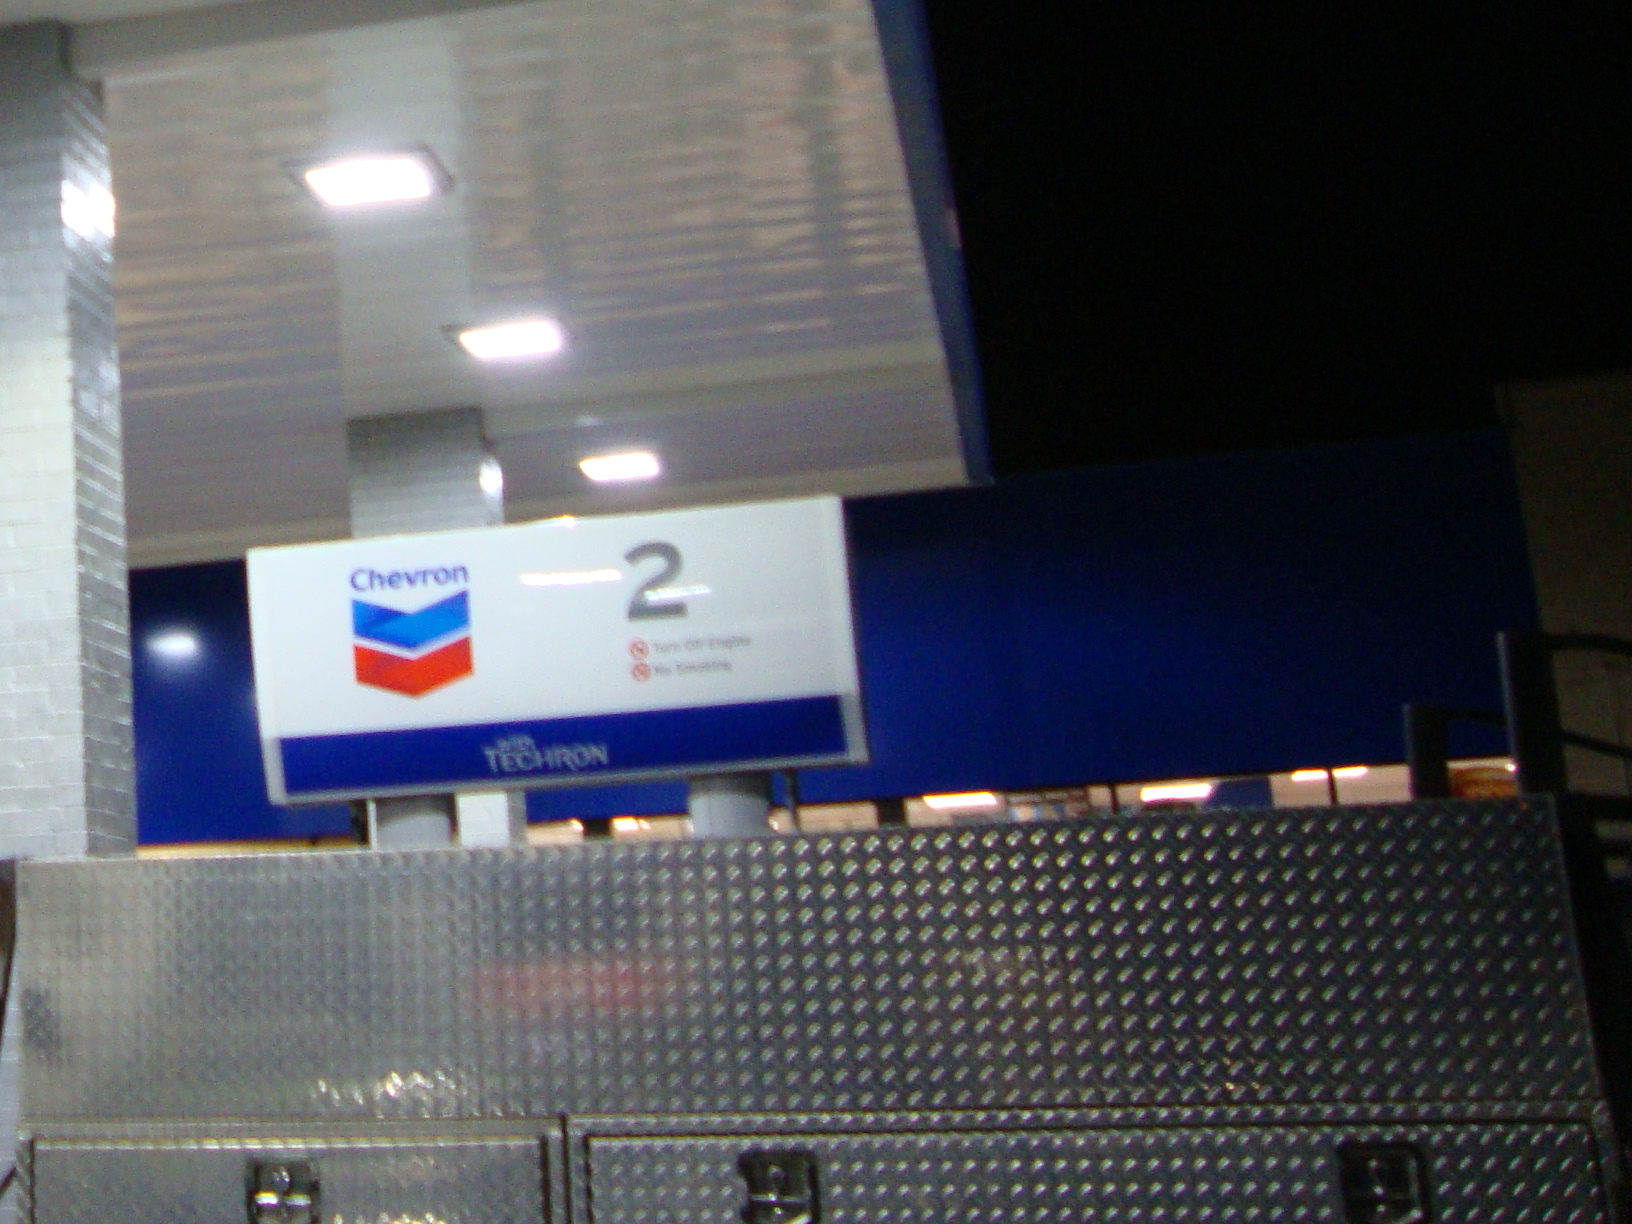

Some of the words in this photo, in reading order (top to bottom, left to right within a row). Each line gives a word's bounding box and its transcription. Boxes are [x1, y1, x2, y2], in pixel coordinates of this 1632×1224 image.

[350, 564, 469, 592] Chevron
[623, 540, 688, 622] 2
[483, 742, 609, 774] TECHRON
